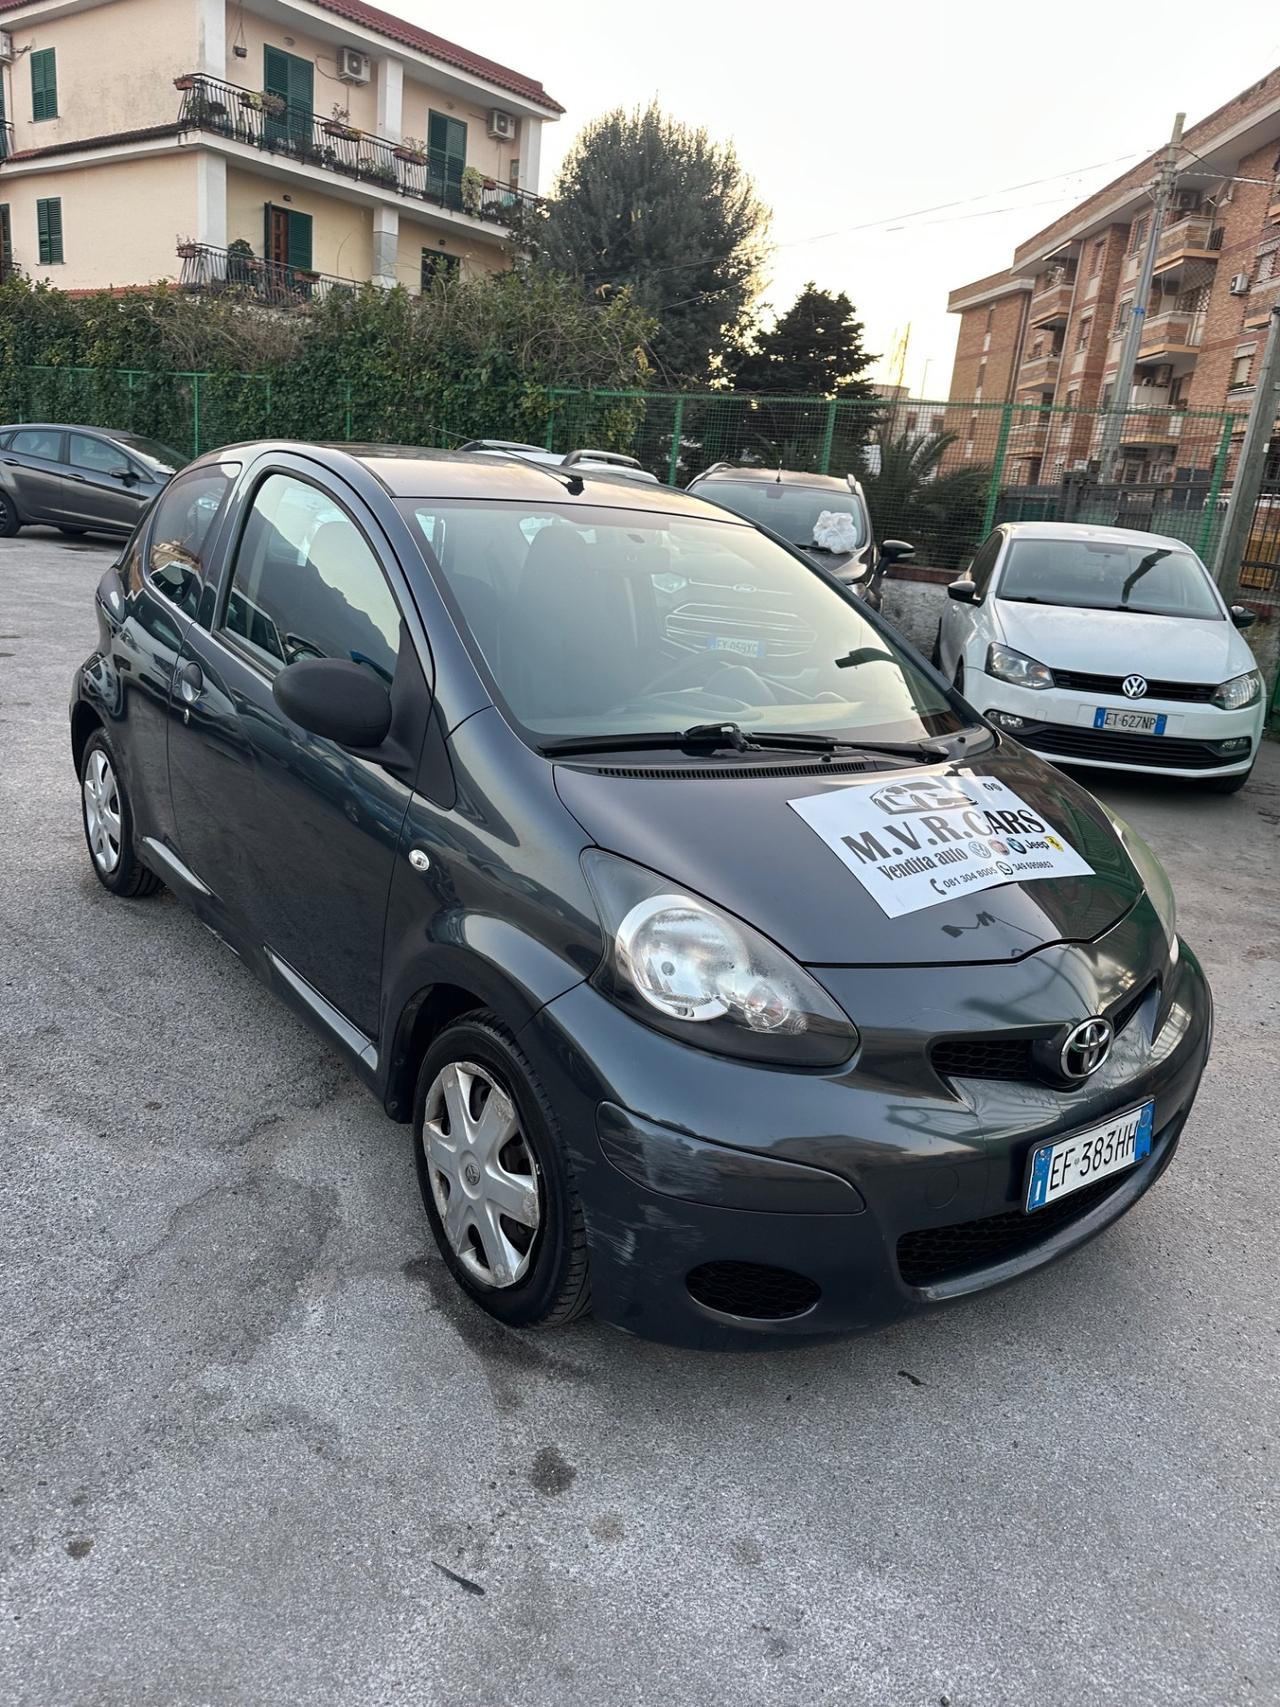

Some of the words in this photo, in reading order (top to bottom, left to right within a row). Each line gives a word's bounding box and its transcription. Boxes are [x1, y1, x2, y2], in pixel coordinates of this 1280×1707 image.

[1121, 714, 1156, 730] 627NP
[840, 809, 1046, 865] M.V.R.CARS
[1025, 839, 1049, 850] Jeep
[876, 856, 938, 881] Vendita
[934, 847, 969, 866] auto
[943, 876, 962, 888] 081
[959, 872, 978, 883] 304
[1049, 1147, 1076, 1191] EF
[1079, 1119, 1139, 1177] 383HH
